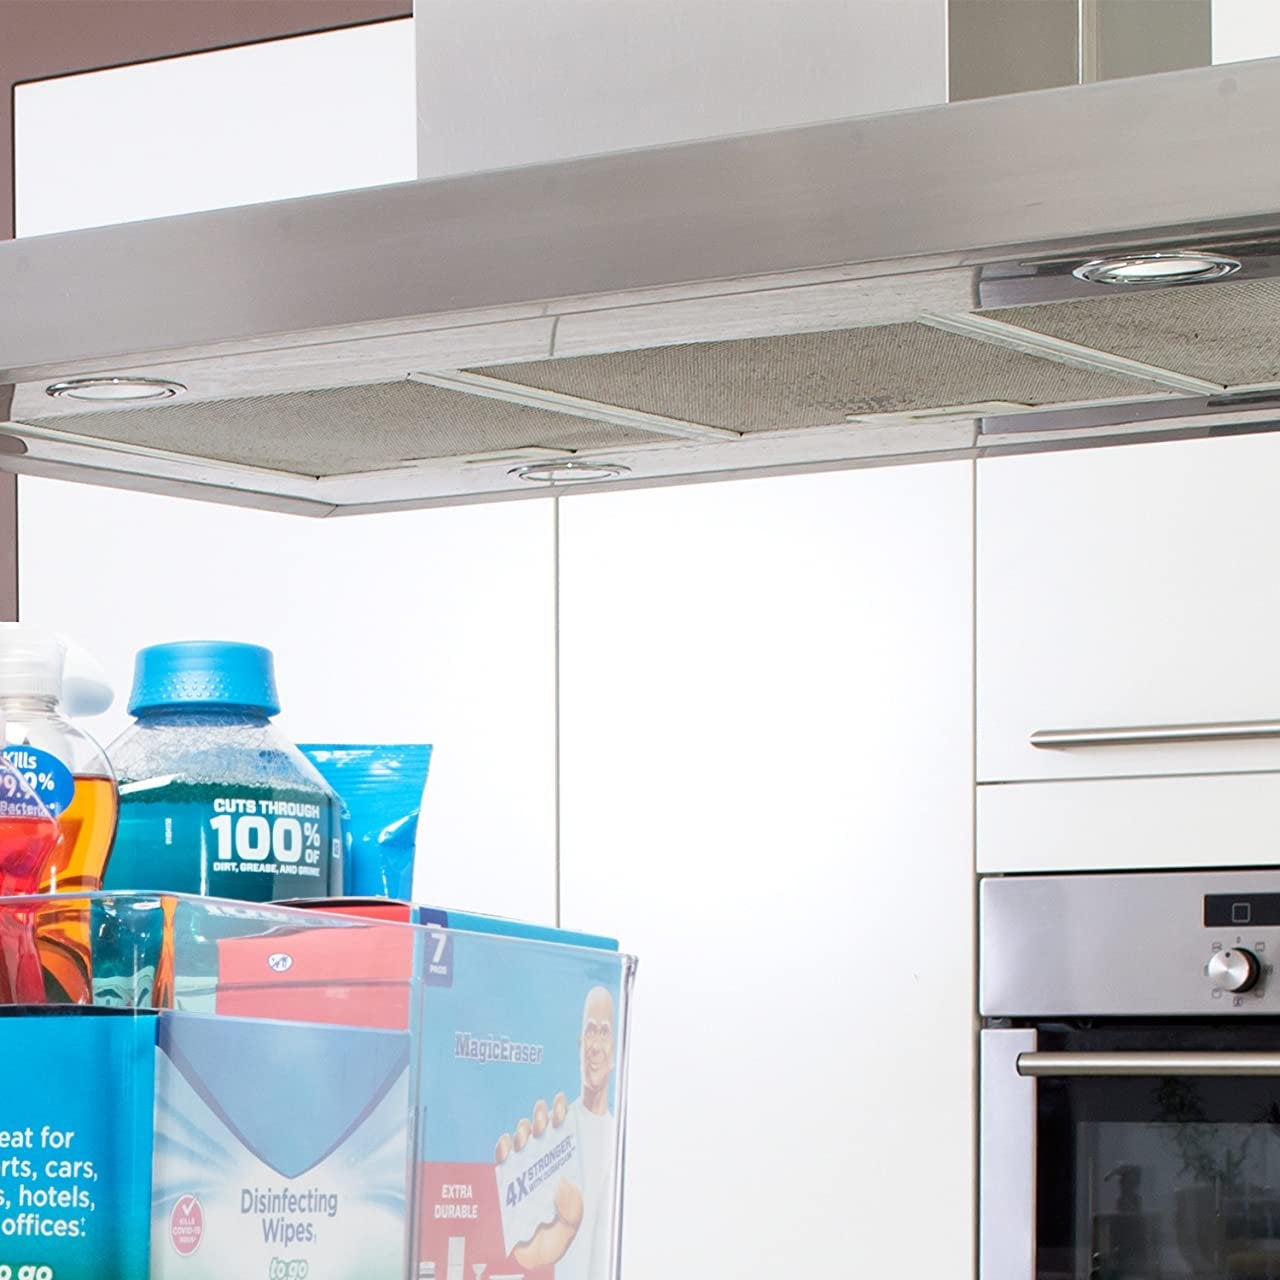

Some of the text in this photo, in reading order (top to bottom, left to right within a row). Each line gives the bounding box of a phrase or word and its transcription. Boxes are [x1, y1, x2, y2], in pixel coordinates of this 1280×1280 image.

[3, 751, 37, 769] Kills
[213, 798, 321, 820] CUTS THROUGH
[304, 849, 321, 865] OF
[213, 862, 239, 873] DIRT,
[240, 862, 279, 876] GREASE,
[279, 864, 298, 875] AND
[426, 922, 448, 964] 7
[429, 964, 448, 975] PADS
[40, 1125, 75, 1149] for
[44, 1159, 98, 1182] cars,
[505, 1135, 572, 1207] 4X STRONGER
[18, 1183, 96, 1211] hotels,
[240, 1187, 338, 1218] Disinfecting
[441, 1184, 473, 1199] EXTRA
[434, 1203, 479, 1219] DURABLE
[269, 1257, 286, 1280] to
